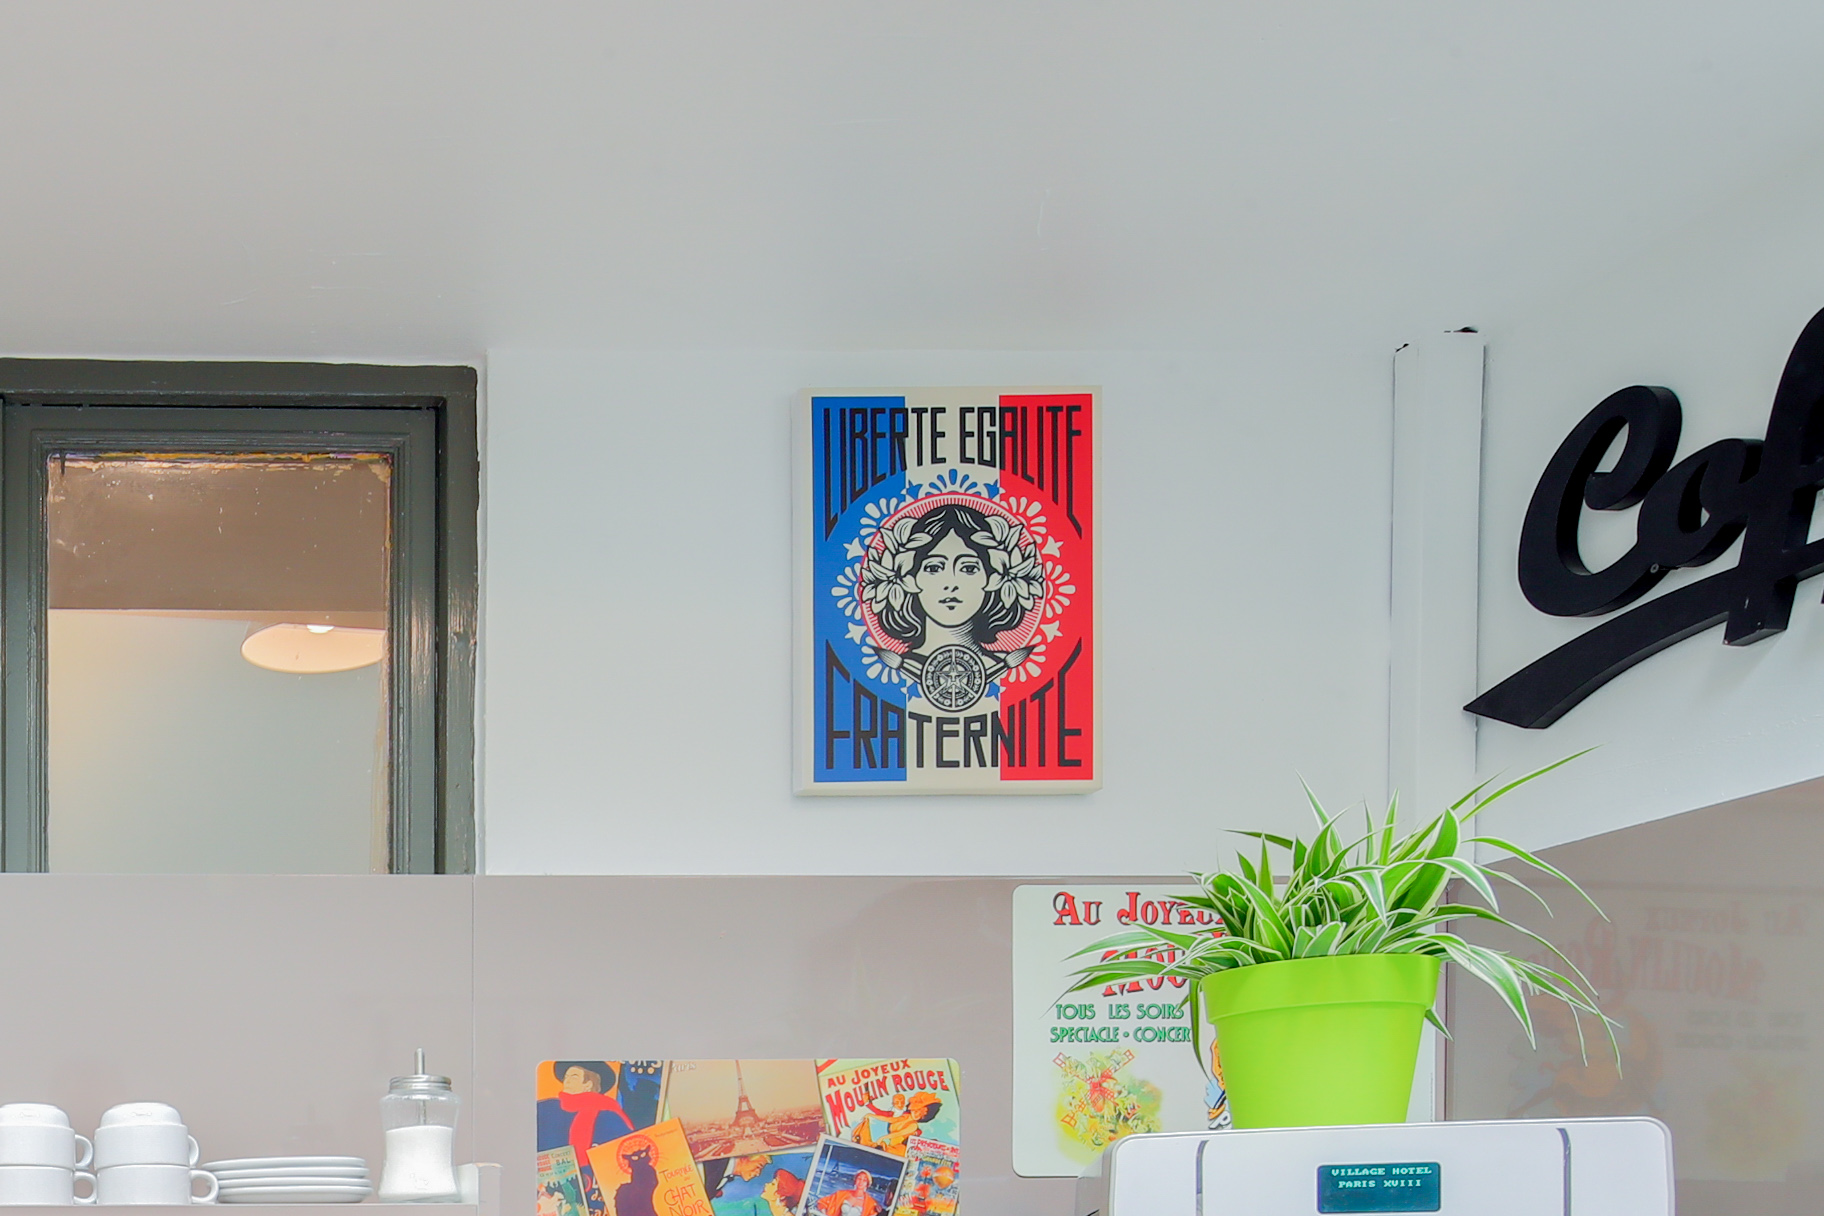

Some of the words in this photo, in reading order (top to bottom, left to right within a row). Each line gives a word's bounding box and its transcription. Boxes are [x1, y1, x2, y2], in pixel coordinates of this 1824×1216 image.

[823, 406, 946, 541] LIBERTE
[959, 405, 1082, 540] EGALITE
[1476, 307, 1824, 700] Cof
[825, 637, 1083, 770] FRATERNITE
[1117, 892, 1228, 925] JOYEU
[1055, 1004, 1096, 1020] TOUS
[1108, 1004, 1131, 1019] LES
[1136, 1004, 1184, 1020] SOIRS
[1050, 1026, 1120, 1043] SPECTACLE
[1133, 1026, 1192, 1043] CONCER
[827, 1074, 847, 1089] AU
[851, 1059, 911, 1086] JOYEUX
[825, 1076, 890, 1138] MOULIN
[891, 1069, 950, 1093] ROUGE
[1331, 1168, 1386, 1176] VILLAGE
[1392, 1167, 1432, 1175] HOTEL
[1338, 1180, 1376, 1188] PARIS
[1383, 1179, 1422, 1187] XVIII
[664, 1183, 697, 1206] CHAT
